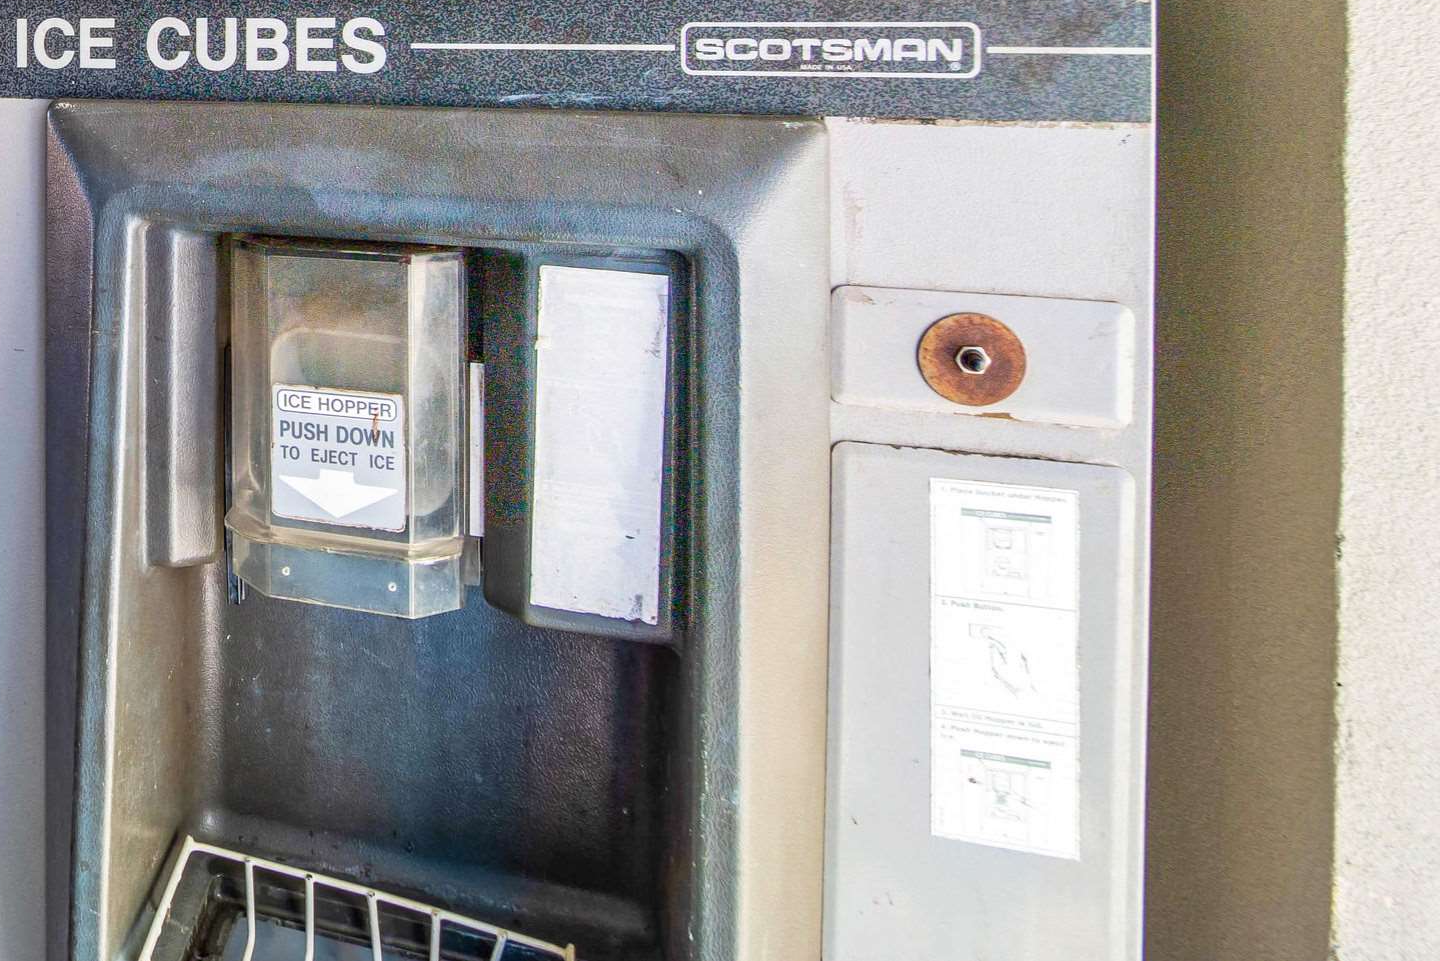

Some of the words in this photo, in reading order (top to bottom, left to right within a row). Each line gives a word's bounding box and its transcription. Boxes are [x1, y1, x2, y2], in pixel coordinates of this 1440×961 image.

[16, 17, 117, 70] ICE
[146, 16, 387, 74] CUBES
[695, 38, 962, 62] SCOTSMAN
[283, 393, 312, 410] ICE
[318, 396, 392, 418] HOPPER
[279, 419, 329, 442] PUSH
[336, 425, 395, 449] DOWN
[281, 445, 300, 461] TO
[311, 448, 358, 467] EJECT
[369, 454, 395, 471] ICE
